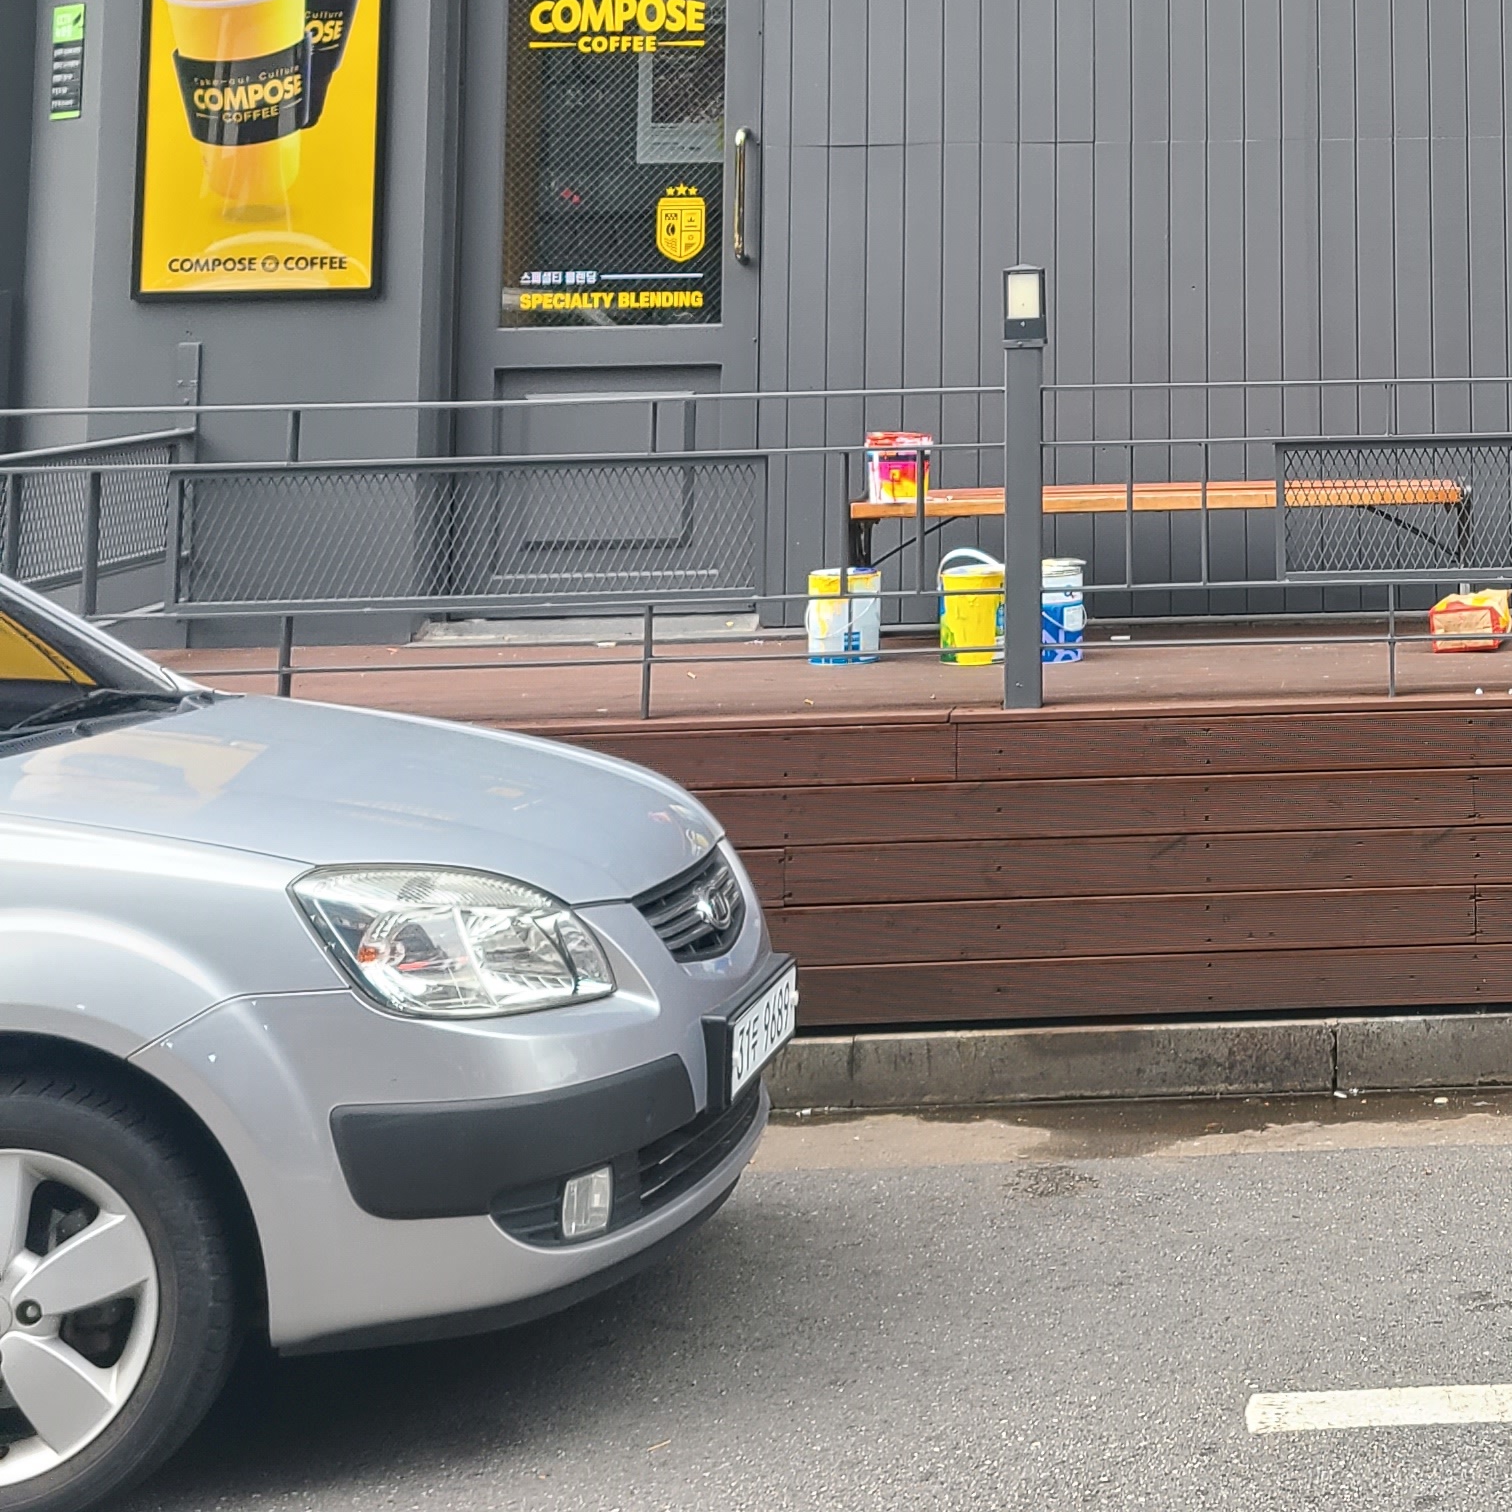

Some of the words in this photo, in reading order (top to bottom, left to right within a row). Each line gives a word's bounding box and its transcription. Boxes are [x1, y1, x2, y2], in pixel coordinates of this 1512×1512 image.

[577, 35, 657, 53] COFFEE
[193, 73, 303, 111] COMPOSE
[222, 104, 280, 124] COFFEE
[168, 257, 257, 273] COMPOSE
[283, 256, 347, 271] COFFEE
[519, 291, 615, 309] SPECIALTY
[617, 290, 704, 308] BLENDING
[762, 979, 790, 1052] 9689
